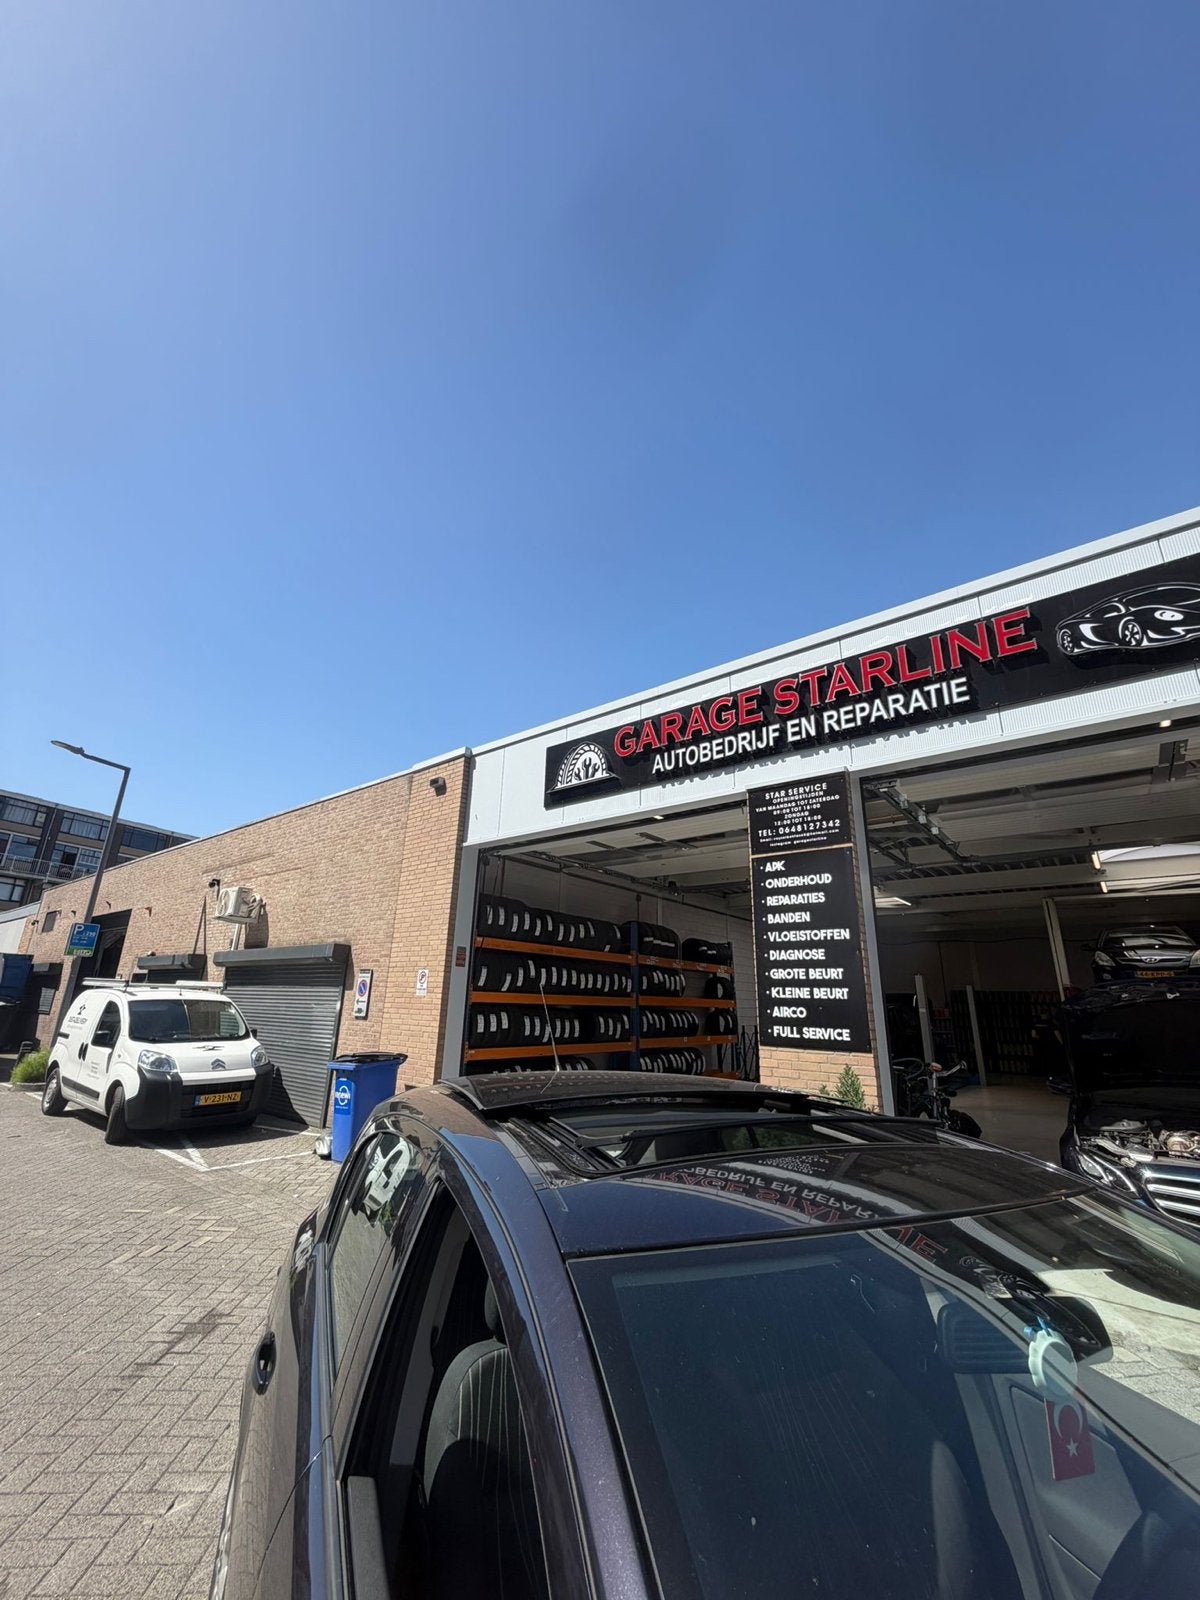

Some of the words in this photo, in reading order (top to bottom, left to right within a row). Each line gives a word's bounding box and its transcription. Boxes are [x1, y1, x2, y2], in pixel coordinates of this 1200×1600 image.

[614, 687, 763, 758] GARAGE
[773, 607, 1038, 715] STARLINE
[651, 723, 782, 775] AUTOBEDRIJF
[786, 715, 818, 743] EN
[824, 677, 970, 736] REPARATIE
[765, 790, 786, 800] STAR
[788, 783, 827, 795] SERVICE
[772, 791, 824, 804] OPENINGSTIJDEN
[768, 803, 796, 811] MAANDAG
[809, 794, 840, 804] ZATERDAG
[784, 811, 809, 819] ZONDAG
[758, 829, 776, 837] TEL:
[779, 819, 840, 834] 0648127342
[765, 861, 786, 873] APK
[765, 873, 832, 889] ONDERHOUD
[766, 892, 825, 907] REPARATIES
[767, 911, 811, 924] BANDEN
[768, 928, 850, 943] VLOEISTOFFEN
[769, 949, 826, 961] DIAGNOSE
[770, 968, 806, 980] GROTE
[809, 967, 844, 980] BEURT
[771, 987, 811, 999] KLEINE
[813, 987, 849, 1000] BEURT
[772, 1006, 807, 1019] AIRCO
[773, 1026, 800, 1039] FULL
[802, 1026, 851, 1041] SERVICE
